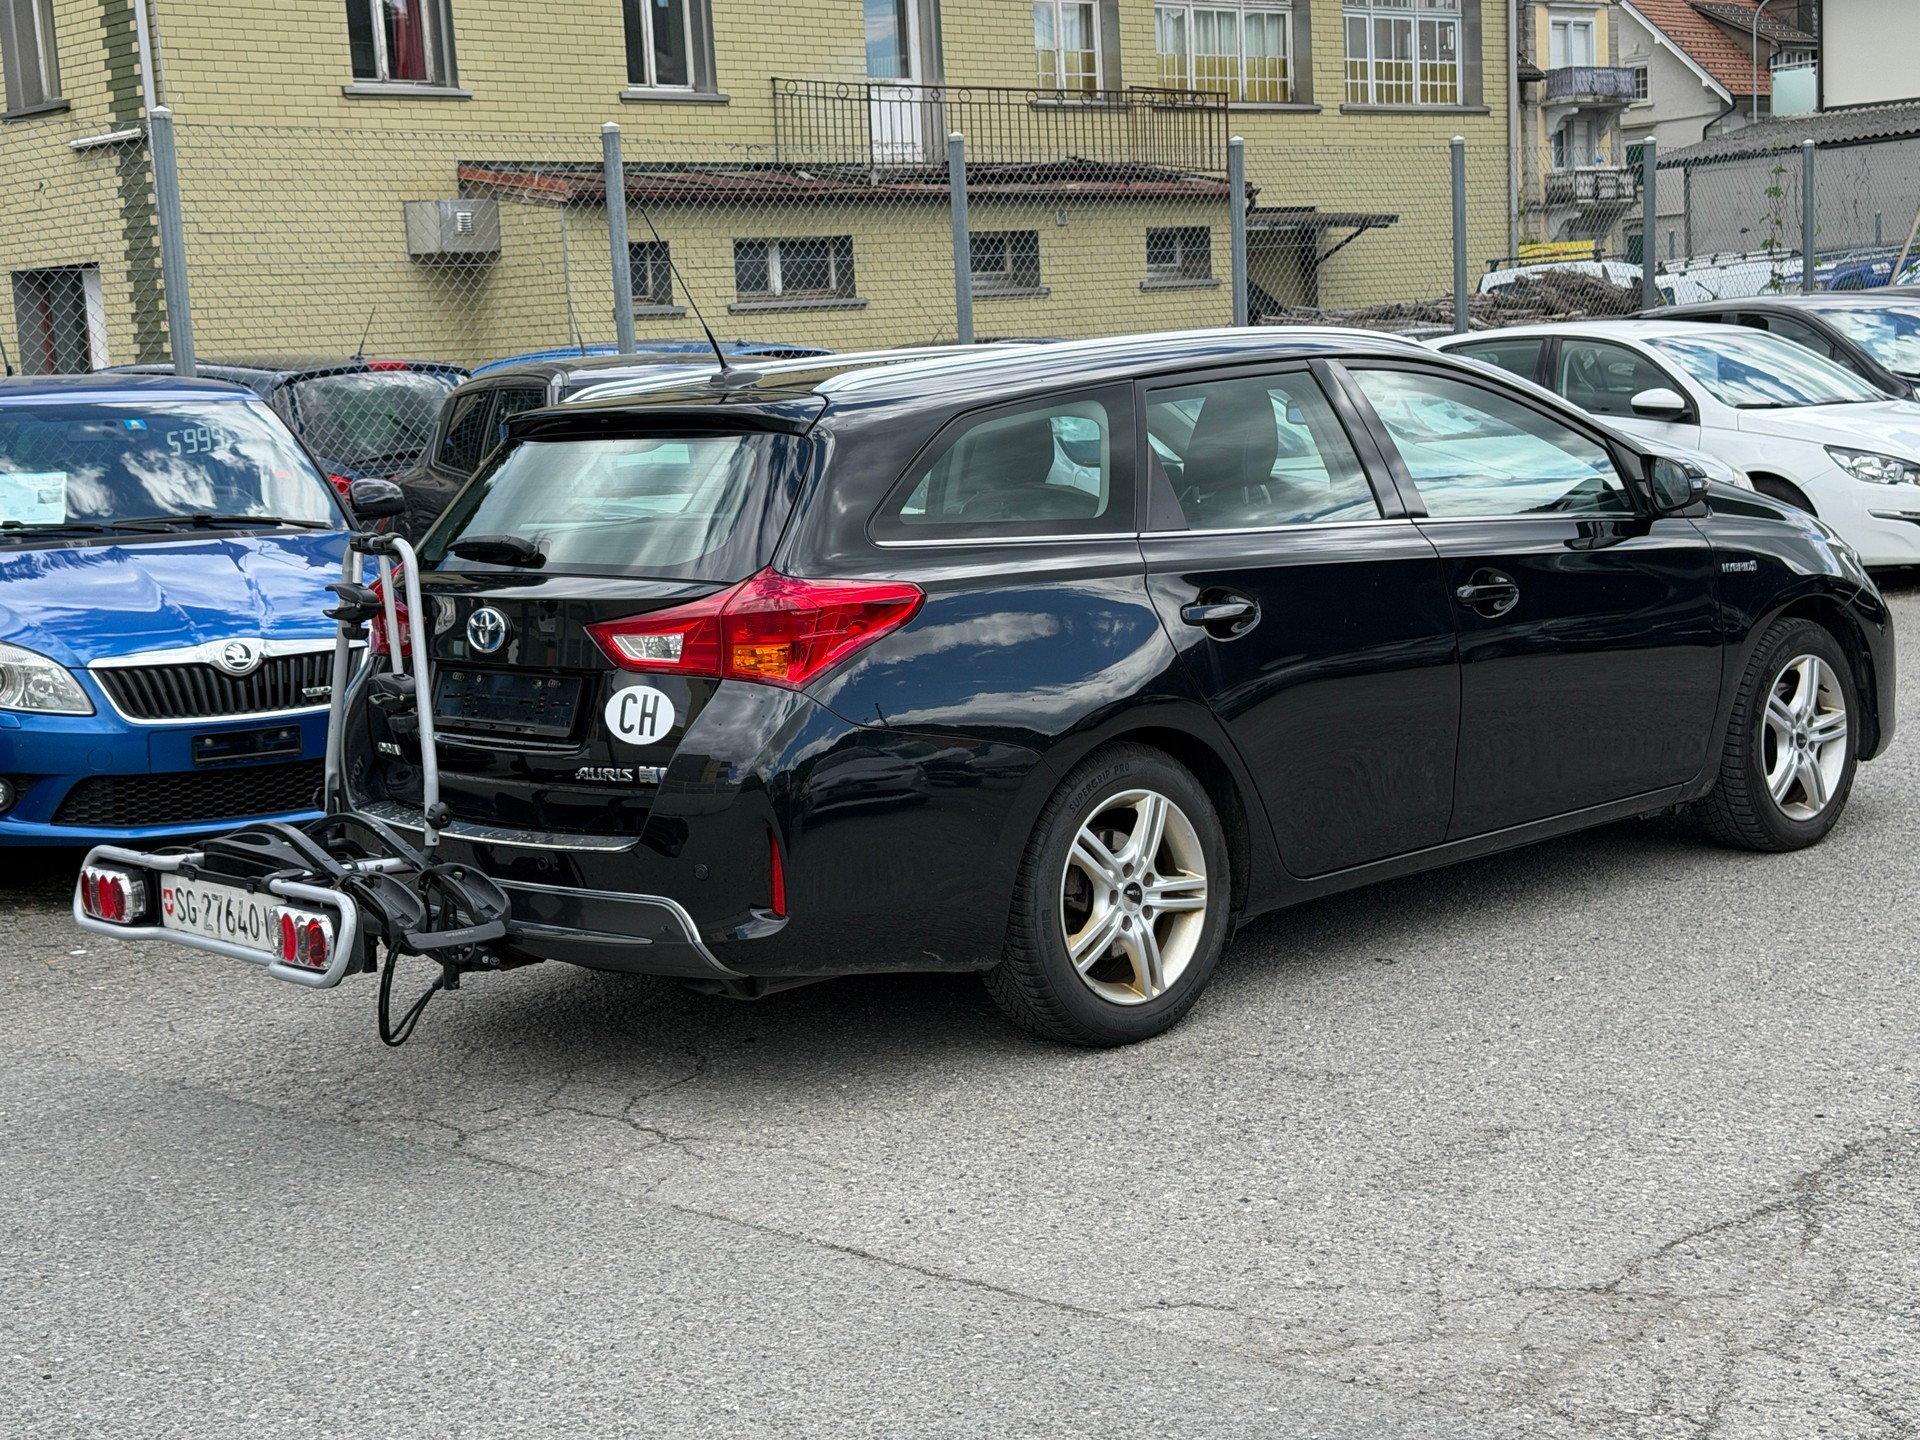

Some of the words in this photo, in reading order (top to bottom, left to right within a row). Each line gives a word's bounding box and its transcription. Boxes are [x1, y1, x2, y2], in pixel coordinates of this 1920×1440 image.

[619, 693, 660, 737] CH
[575, 766, 634, 782] AURIS
[1069, 769, 1111, 814] SUPERGRIP
[1114, 762, 1130, 775] PRO
